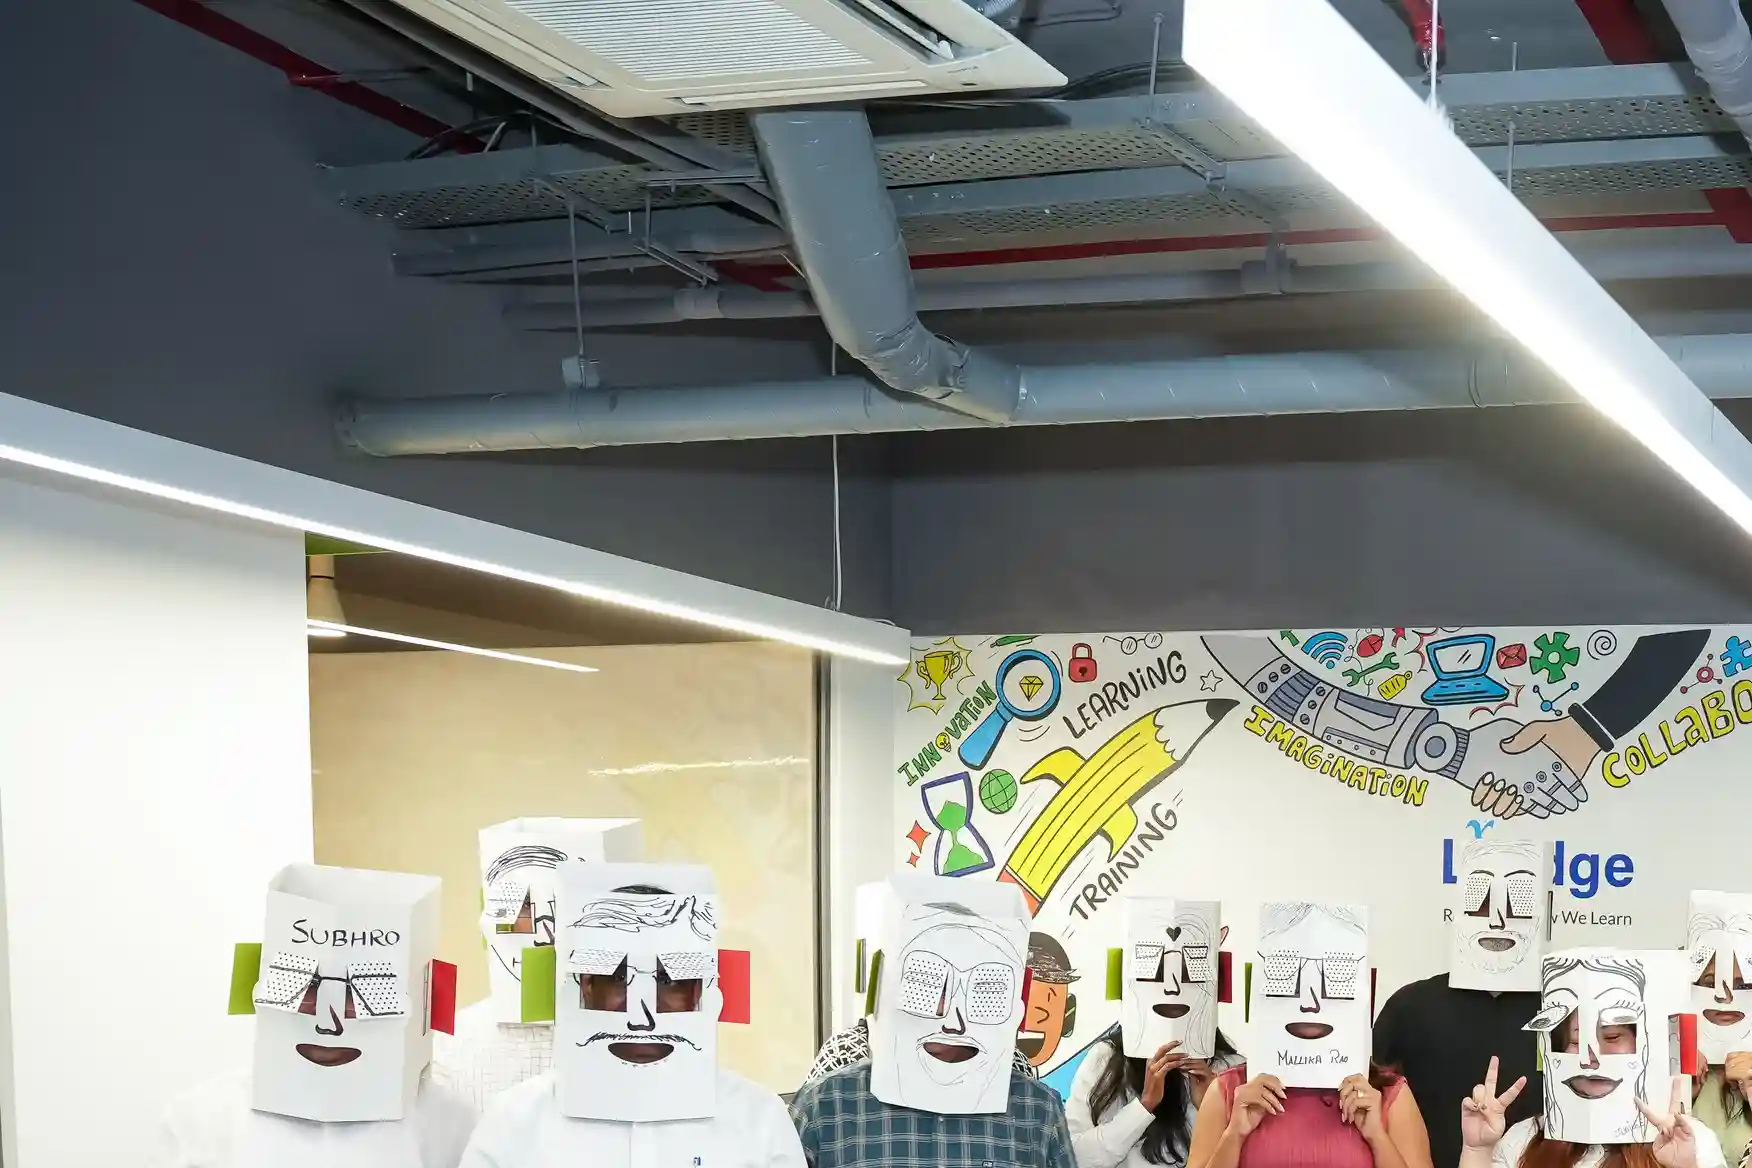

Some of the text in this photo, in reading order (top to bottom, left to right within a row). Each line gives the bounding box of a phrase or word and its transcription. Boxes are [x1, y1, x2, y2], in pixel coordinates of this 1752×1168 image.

[1069, 802, 1178, 920] TRAINING
[1561, 910, 1587, 925] We
[1591, 910, 1632, 926] Learn
[291, 918, 400, 947] SUBHRO
[1277, 1049, 1322, 1066] MALLIKA
